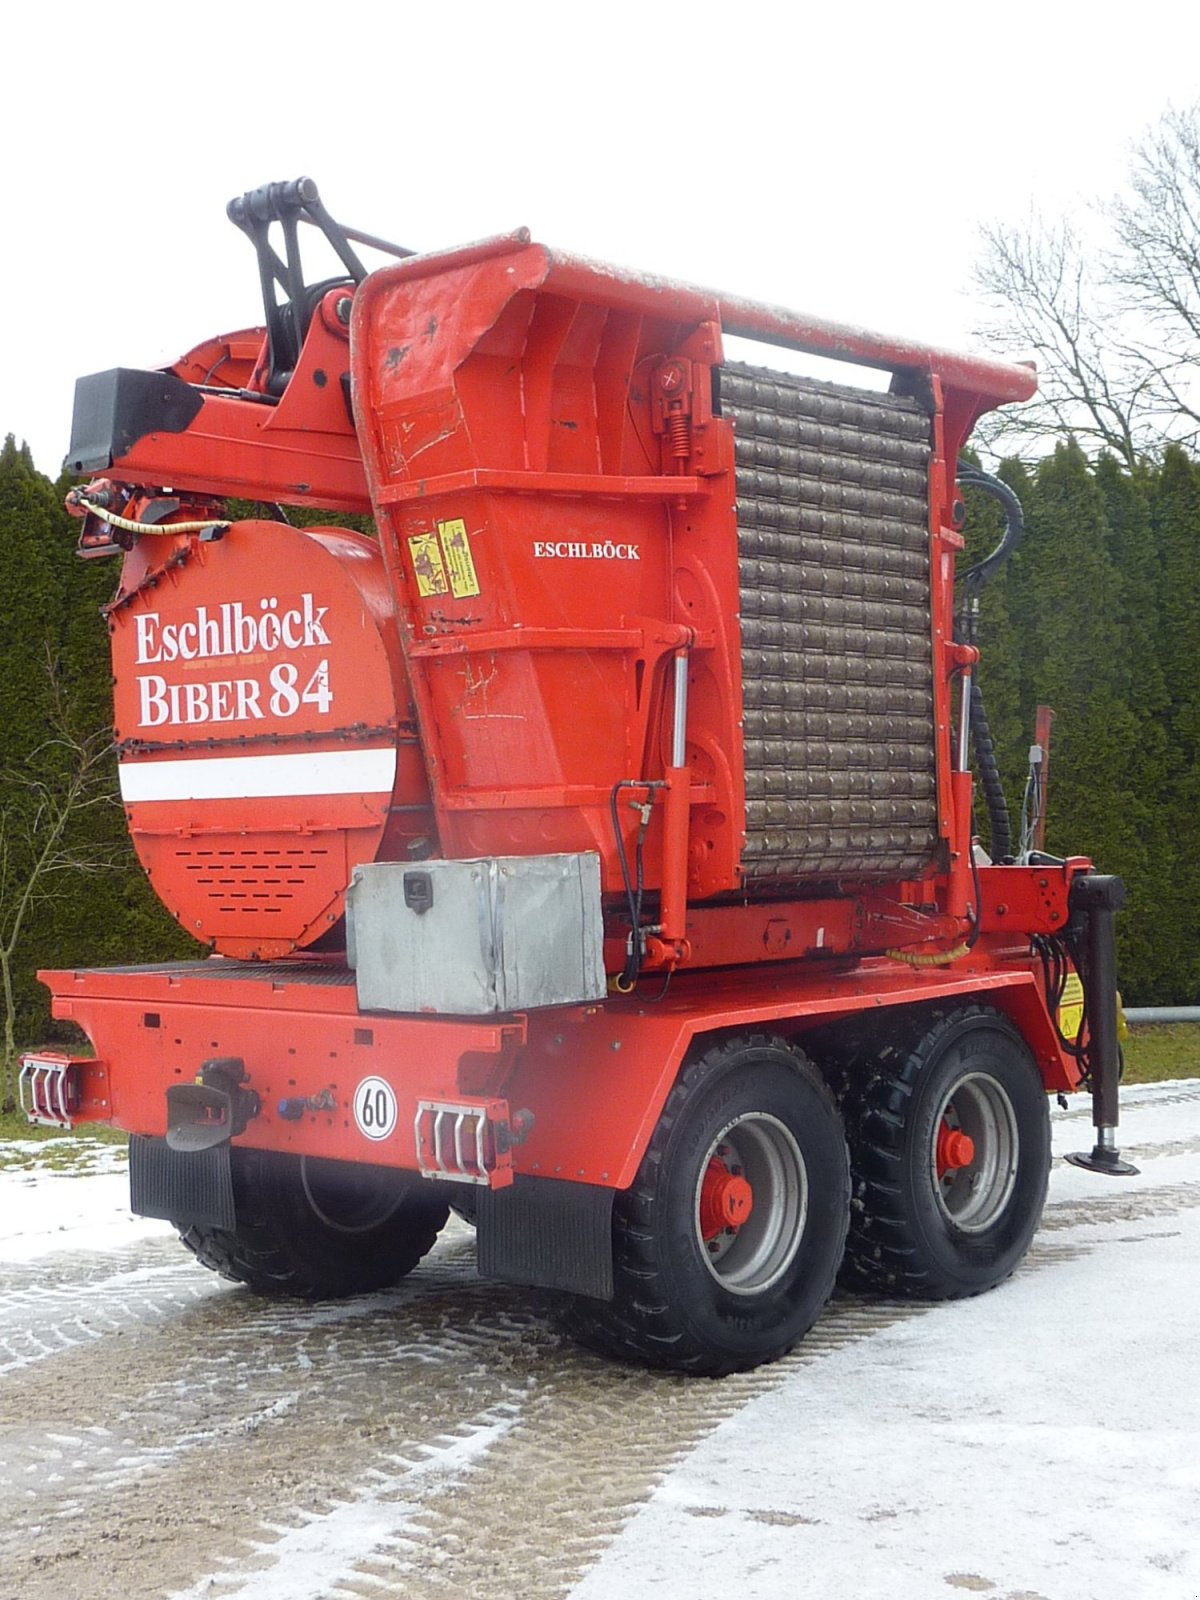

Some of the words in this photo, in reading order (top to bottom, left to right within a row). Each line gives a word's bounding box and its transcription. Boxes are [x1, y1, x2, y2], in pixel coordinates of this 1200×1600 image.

[533, 540, 640, 560] ESCHLBÖCK
[133, 593, 332, 665] Eschlböck
[136, 674, 266, 727] BIBER
[269, 659, 334, 718] 84
[363, 1088, 387, 1128] 60
